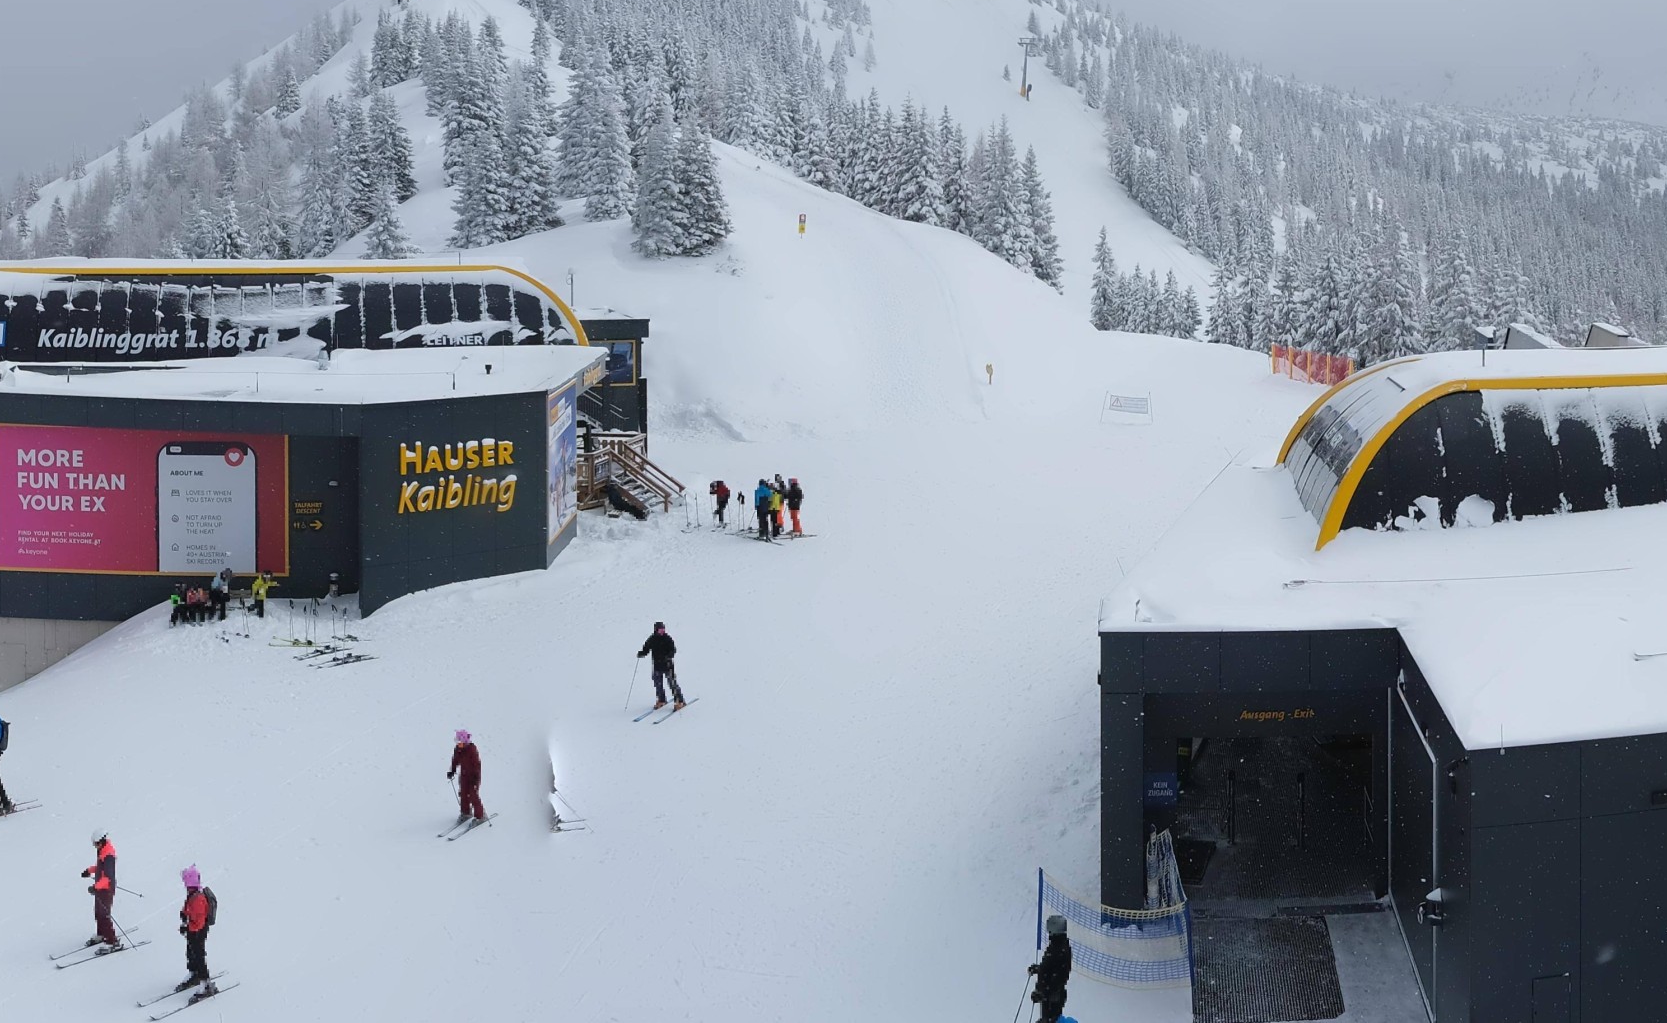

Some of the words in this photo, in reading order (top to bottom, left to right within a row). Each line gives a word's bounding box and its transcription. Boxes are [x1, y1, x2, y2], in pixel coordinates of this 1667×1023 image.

[37, 327, 179, 354] Kaiblinggrat
[427, 335, 484, 346] LEITNER
[17, 448, 84, 468] MORE
[400, 438, 514, 475] HAUSER
[17, 472, 58, 489] FUN
[66, 473, 125, 490] THAN
[18, 494, 74, 511] YOUR
[80, 496, 106, 512] EX
[398, 474, 518, 514] Kaibling
[1239, 710, 1285, 722] Ausgang
[1294, 708, 1315, 719] Exit
[1148, 789, 1173, 797] ZUGANG
